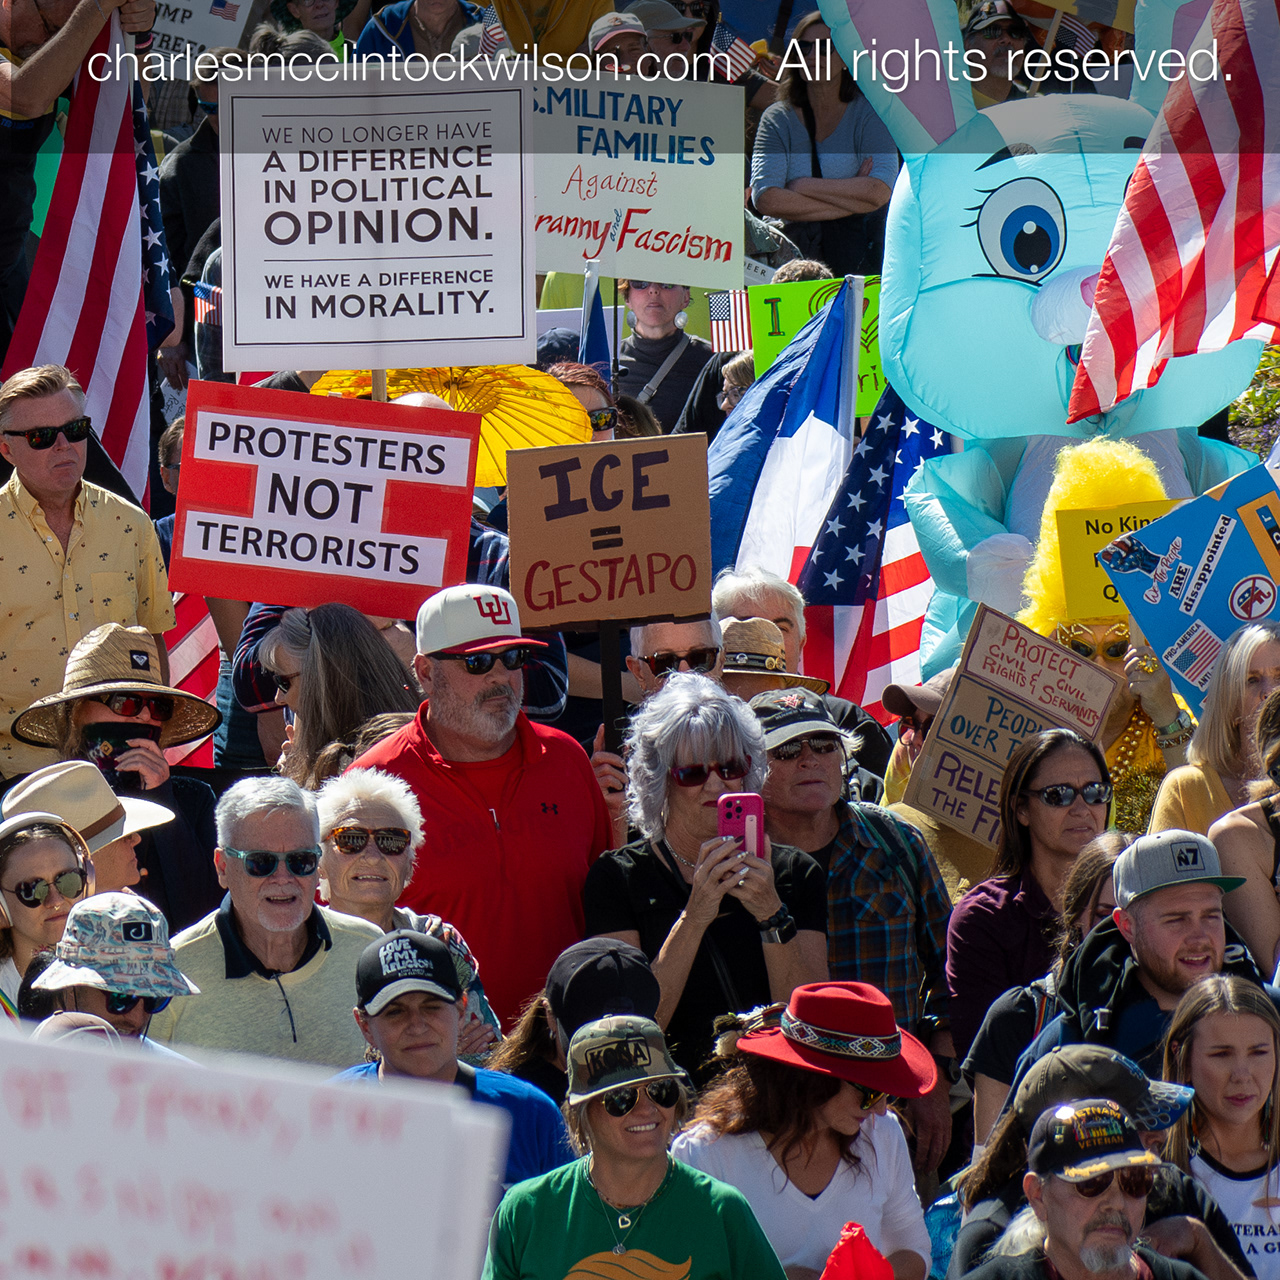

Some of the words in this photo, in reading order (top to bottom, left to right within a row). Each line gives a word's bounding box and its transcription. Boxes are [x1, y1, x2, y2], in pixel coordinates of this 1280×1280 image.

[262, 126, 289, 144] WE
[294, 125, 327, 144] NO
[332, 122, 430, 143] LONGER
[435, 121, 492, 141] HAVE
[576, 126, 716, 166] FAMILIES
[262, 151, 286, 173] A
[299, 145, 493, 172] DIFFERENCE
[264, 181, 296, 205] IN
[311, 173, 493, 204] POLITICAL
[561, 164, 659, 200] Against
[264, 208, 493, 246] OPINION.
[264, 275, 293, 290] WE
[301, 273, 351, 288] HAVE
[356, 272, 372, 287] A
[377, 268, 494, 287] DIFFERENCE
[265, 295, 297, 320] IN
[312, 289, 495, 319] MORALITY.
[207, 421, 446, 475] PROTESTERS
[268, 473, 374, 524] NOT
[539, 449, 671, 522] ICE
[196, 521, 420, 576] TERRORISTS
[1183, 515, 1232, 614] disappointed
[523, 552, 698, 611] GESTAPO
[1170, 564, 1189, 598] ARE
[1001, 623, 1083, 681] PROTECT
[1163, 621, 1204, 662] PRO-AMERICA
[1037, 685, 1100, 728] SERVANTS
[950, 714, 999, 754] OVER
[1077, 1135, 1125, 1150] VETERAN
